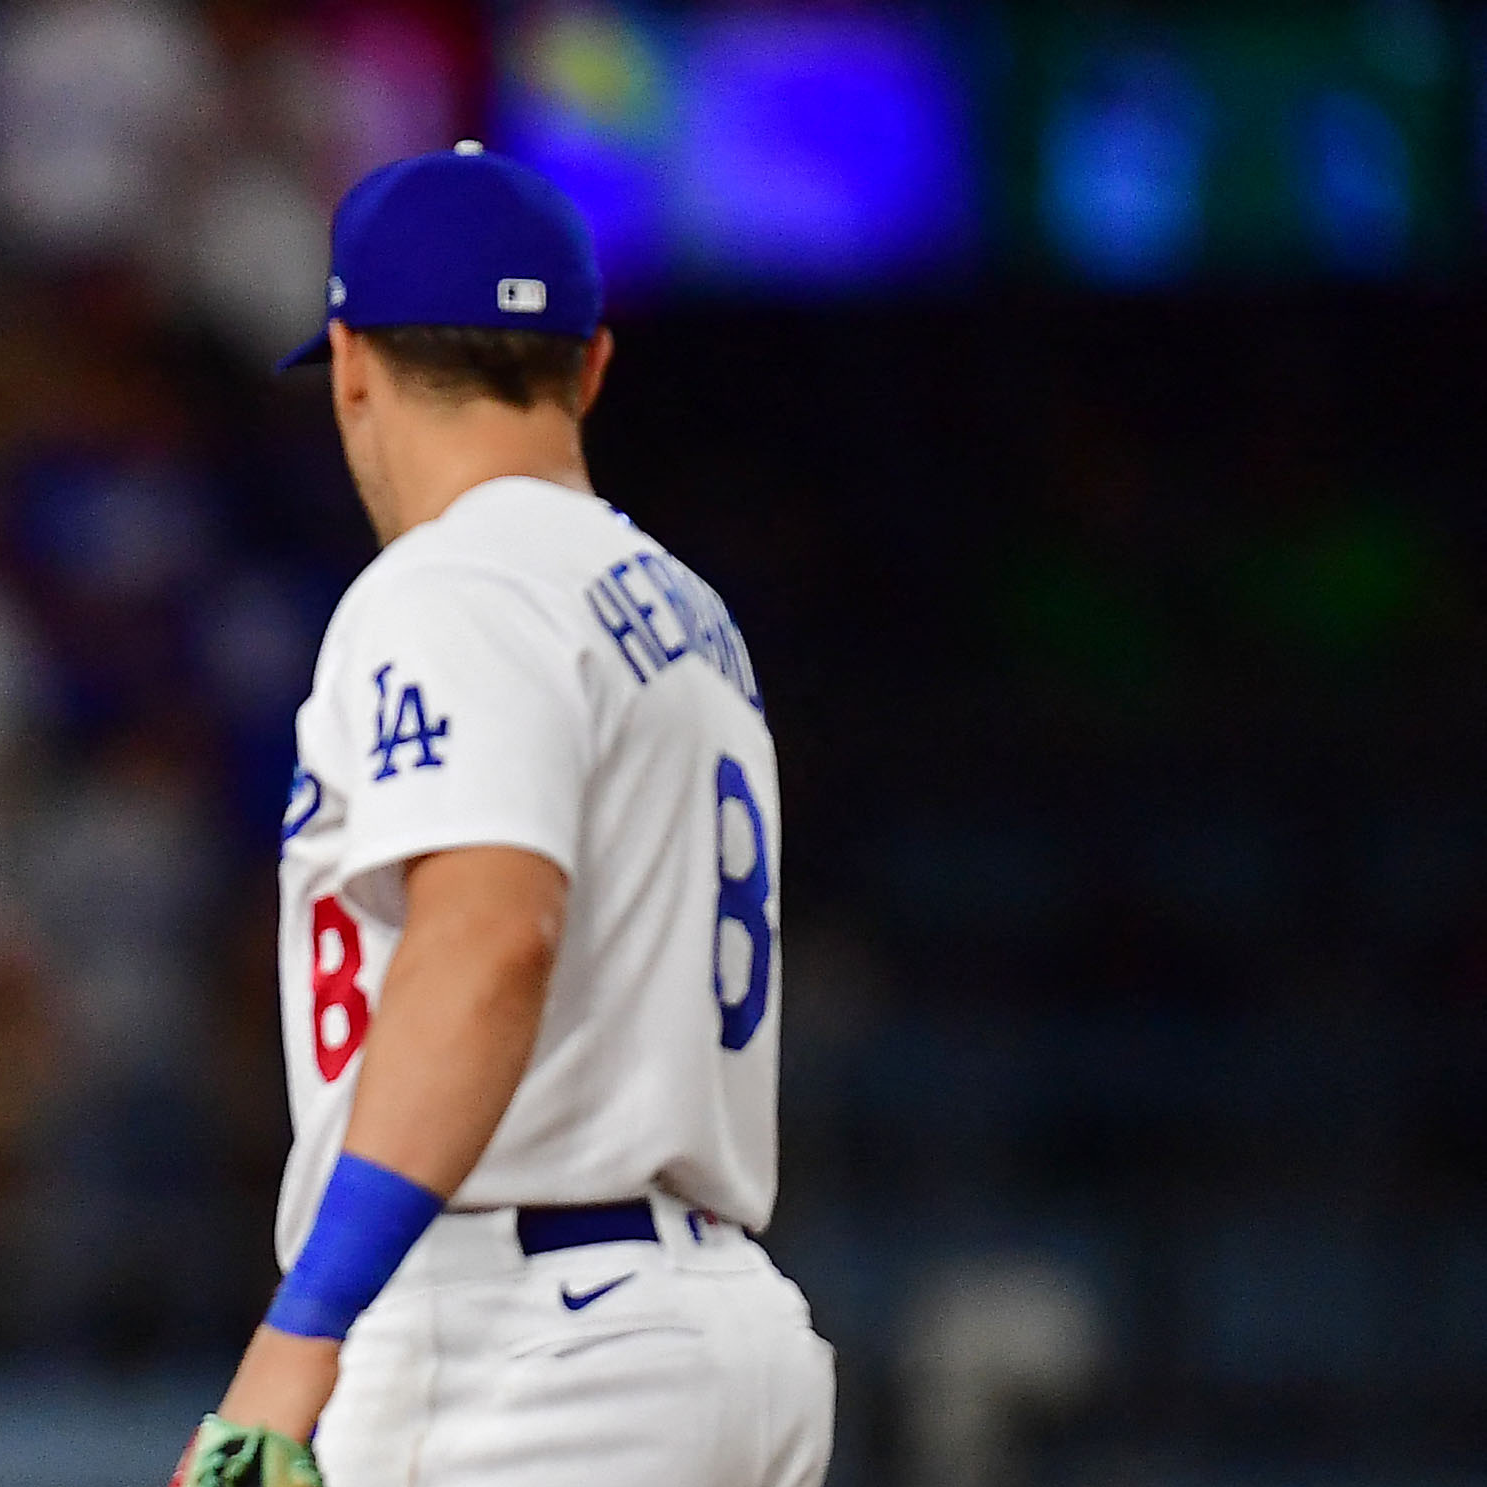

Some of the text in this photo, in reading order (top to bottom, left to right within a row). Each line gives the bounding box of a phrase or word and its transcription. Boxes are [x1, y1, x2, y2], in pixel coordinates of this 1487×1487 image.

[371, 660, 450, 782] LA
[312, 896, 372, 1082] 8
[712, 752, 772, 1052] 8
